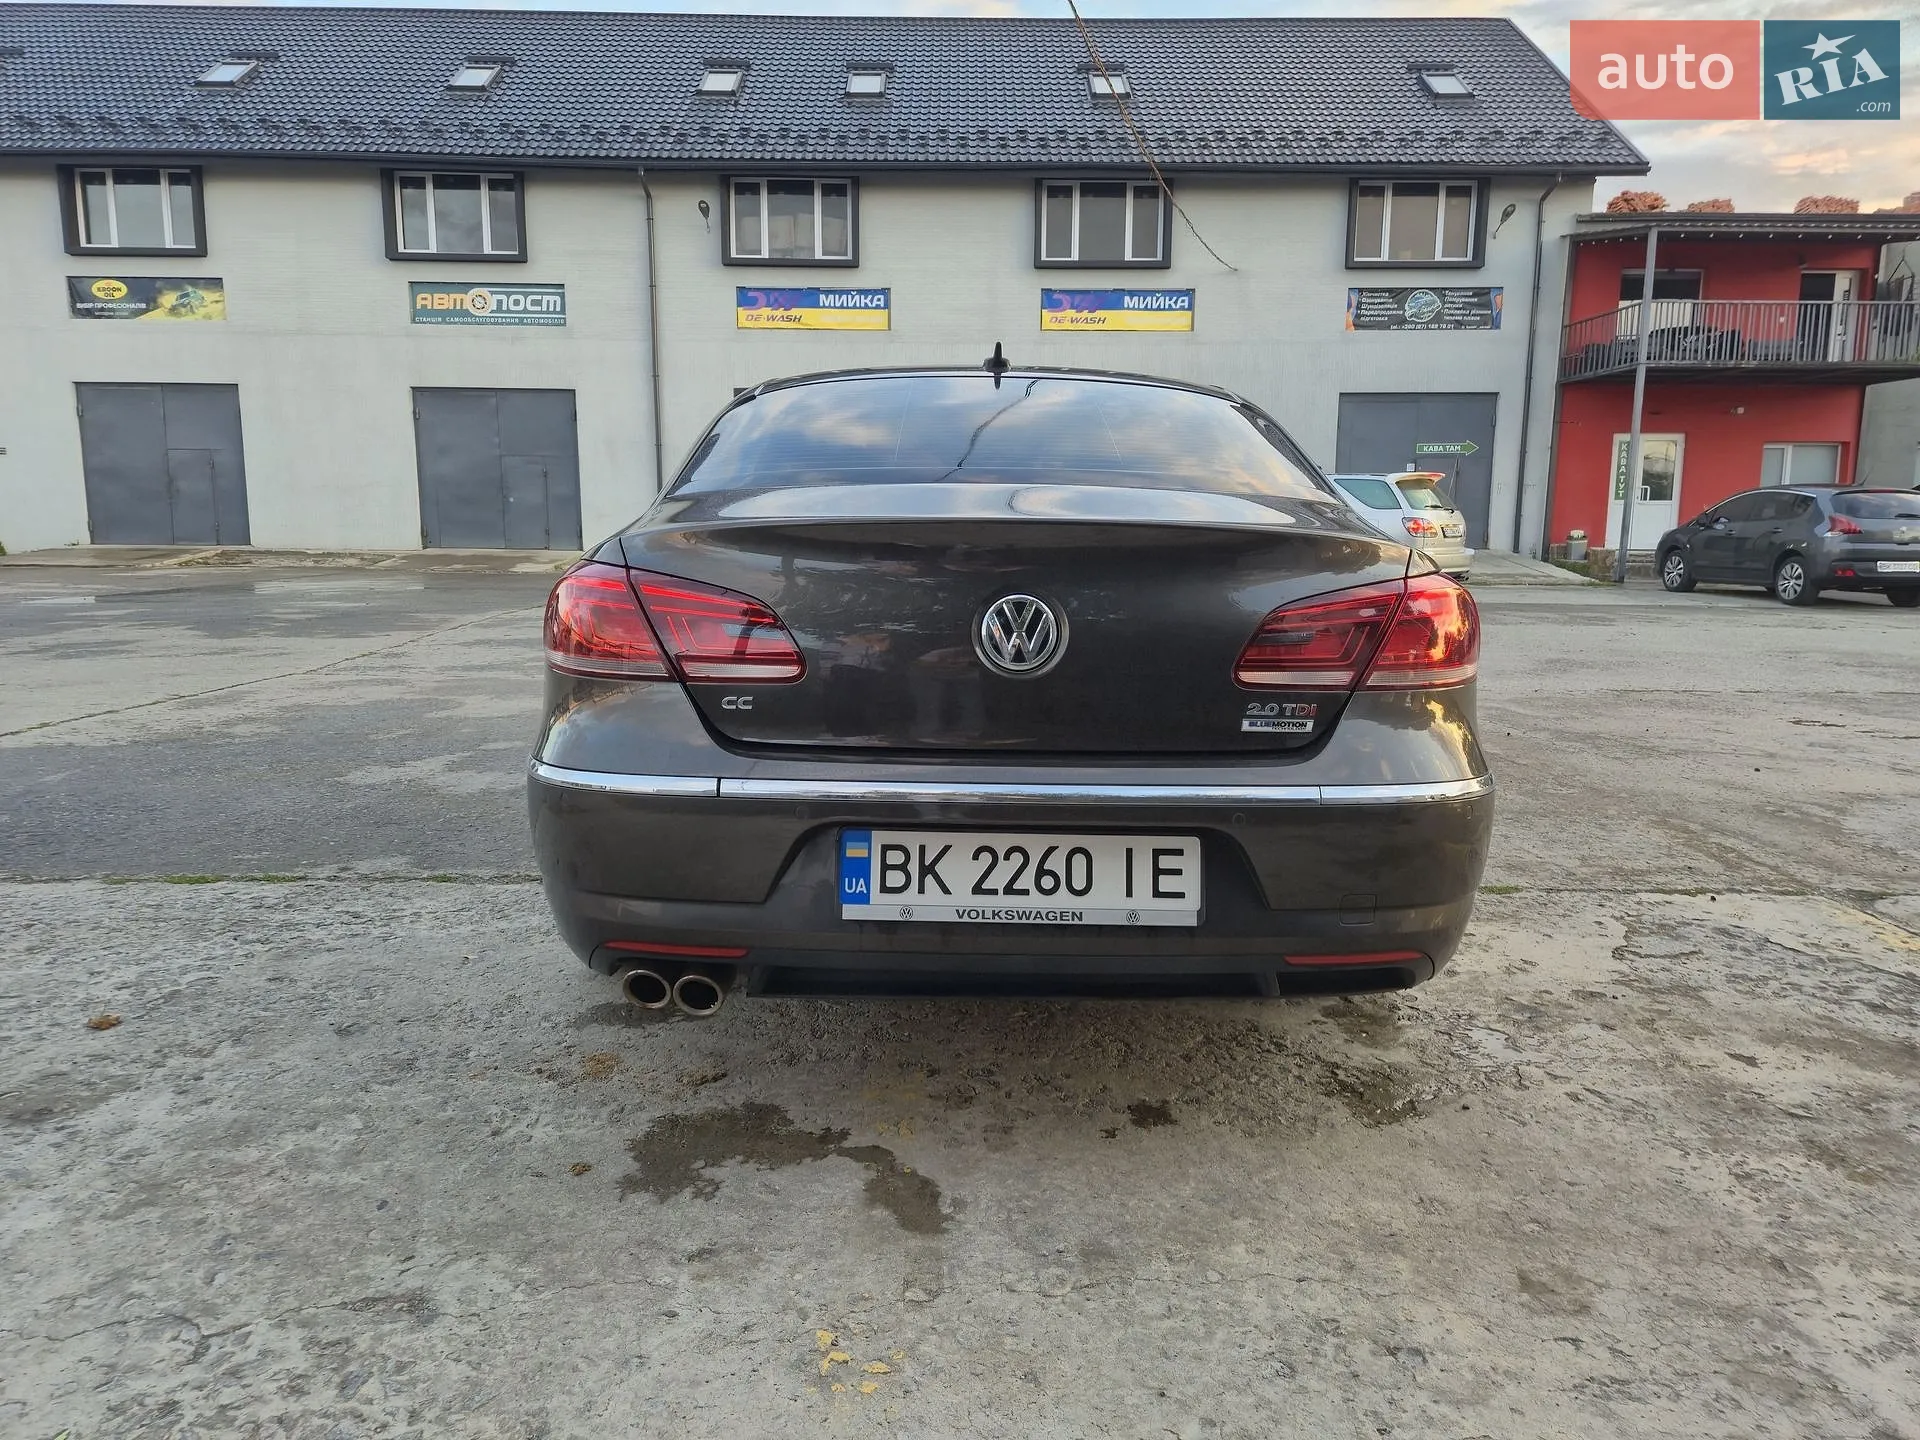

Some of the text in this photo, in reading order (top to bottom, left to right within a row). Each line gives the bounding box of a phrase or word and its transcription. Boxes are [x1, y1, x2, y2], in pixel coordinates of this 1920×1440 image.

[819, 291, 885, 308] МИЙКА
[1123, 293, 1189, 309] МИЙКА
[1617, 443, 1628, 497] КАВА ТУТ
[721, 696, 753, 709] CC
[1246, 702, 1317, 716] 2.0 TDI
[1248, 720, 1308, 728] BLUEMOTION
[879, 843, 1186, 899] BK 2260 IE
[844, 877, 868, 894] UA
[955, 908, 1084, 923] VOLKSWAGEN
